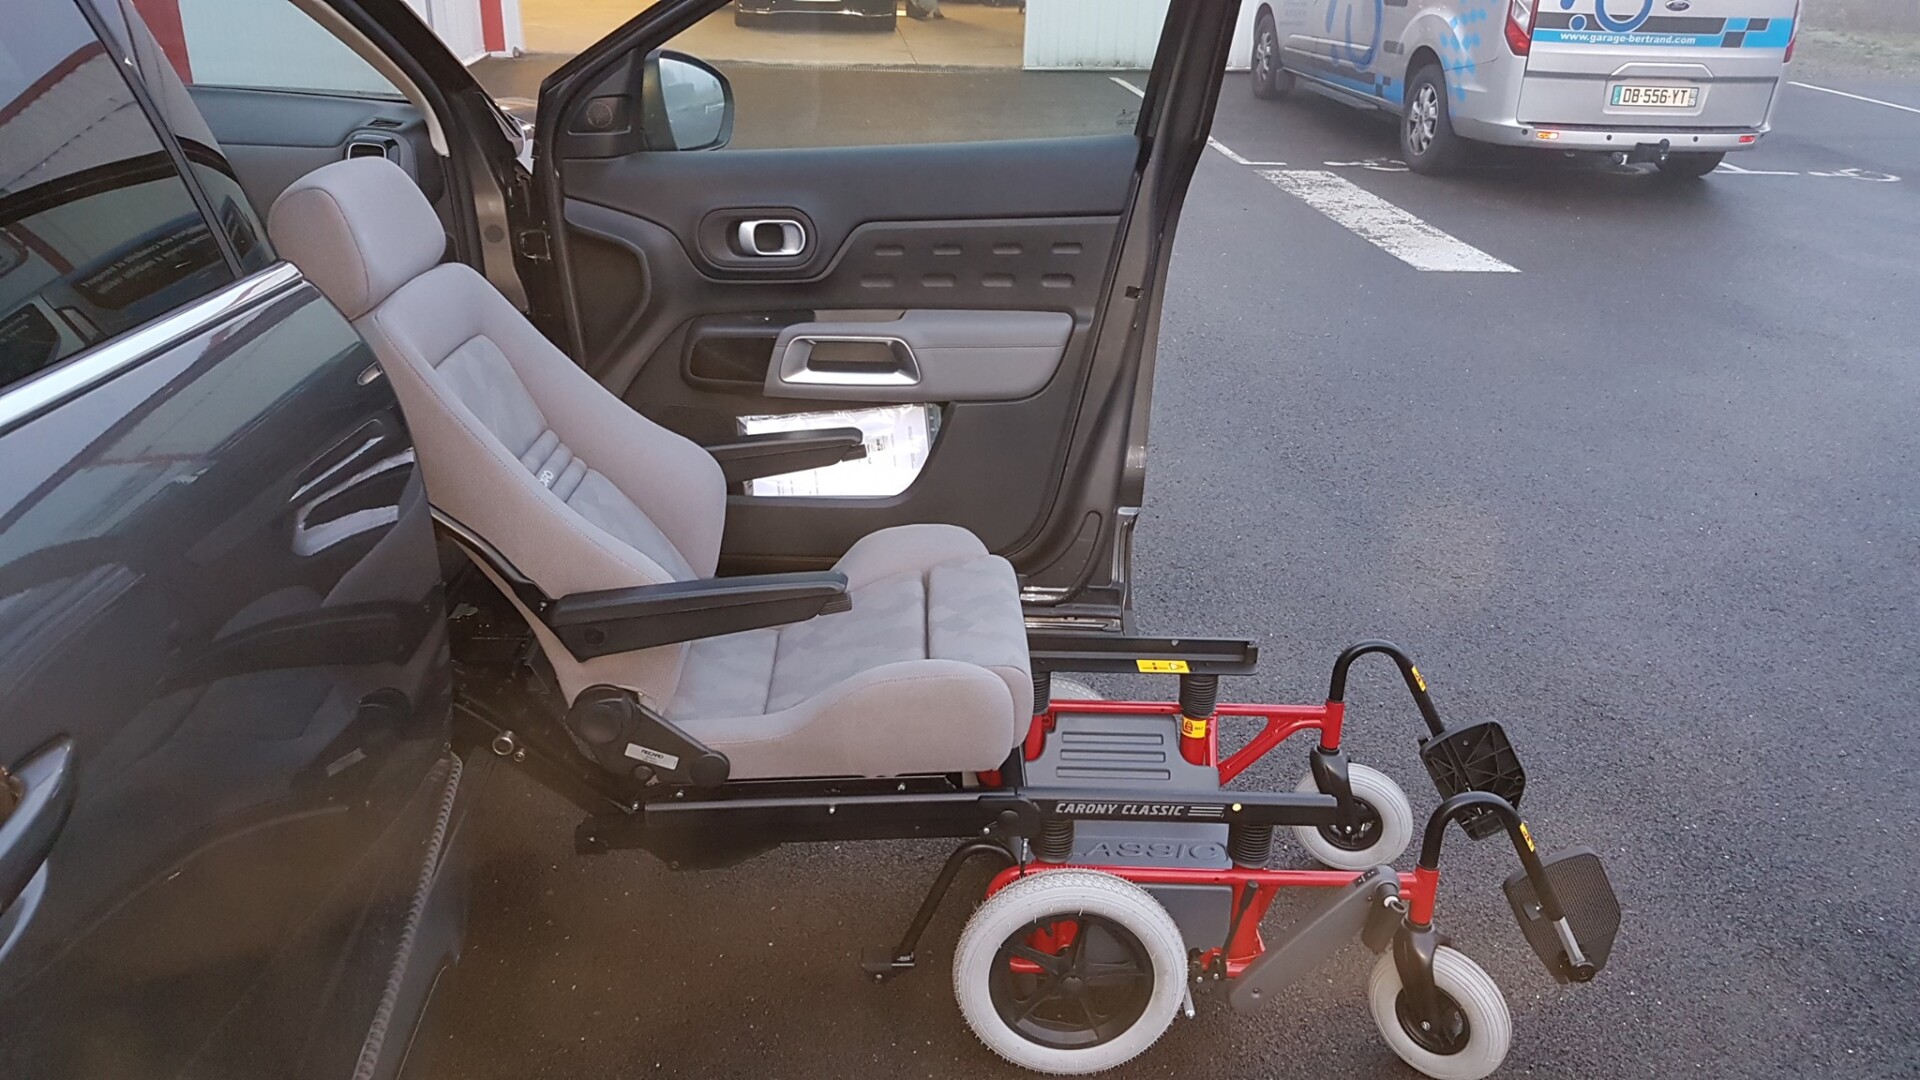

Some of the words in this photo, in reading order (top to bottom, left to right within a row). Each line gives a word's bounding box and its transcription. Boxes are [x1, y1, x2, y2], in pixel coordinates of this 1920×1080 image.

[1560, 32, 1696, 45] www.garage-bertrand.com
[1622, 88, 1688, 104] DB-556-YT
[1055, 803, 1118, 814] CARONY
[1121, 804, 1184, 816] CLASSIC
[1069, 841, 1219, 860] ASSIC
